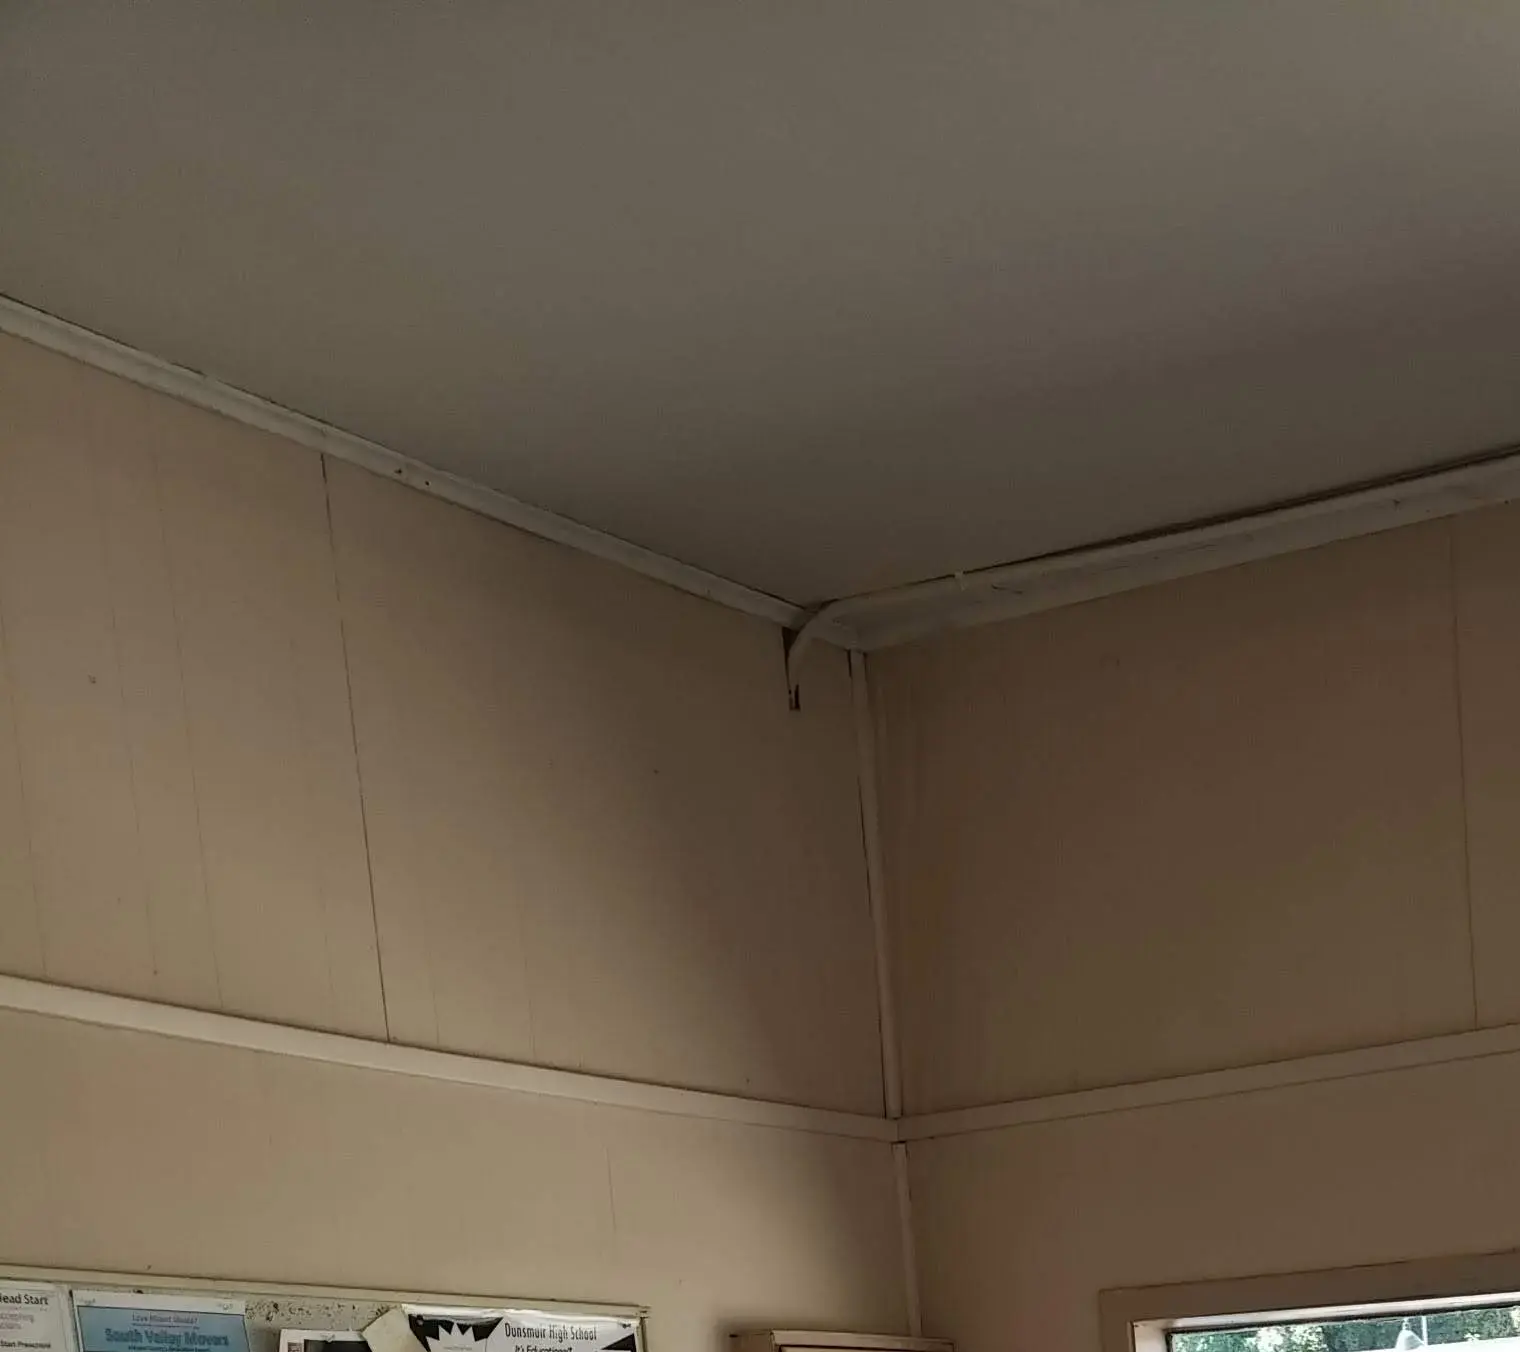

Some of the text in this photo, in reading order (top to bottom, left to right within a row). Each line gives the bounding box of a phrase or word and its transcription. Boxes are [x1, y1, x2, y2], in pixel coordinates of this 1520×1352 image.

[504, 1321, 598, 1343] Dunsmuir High School
